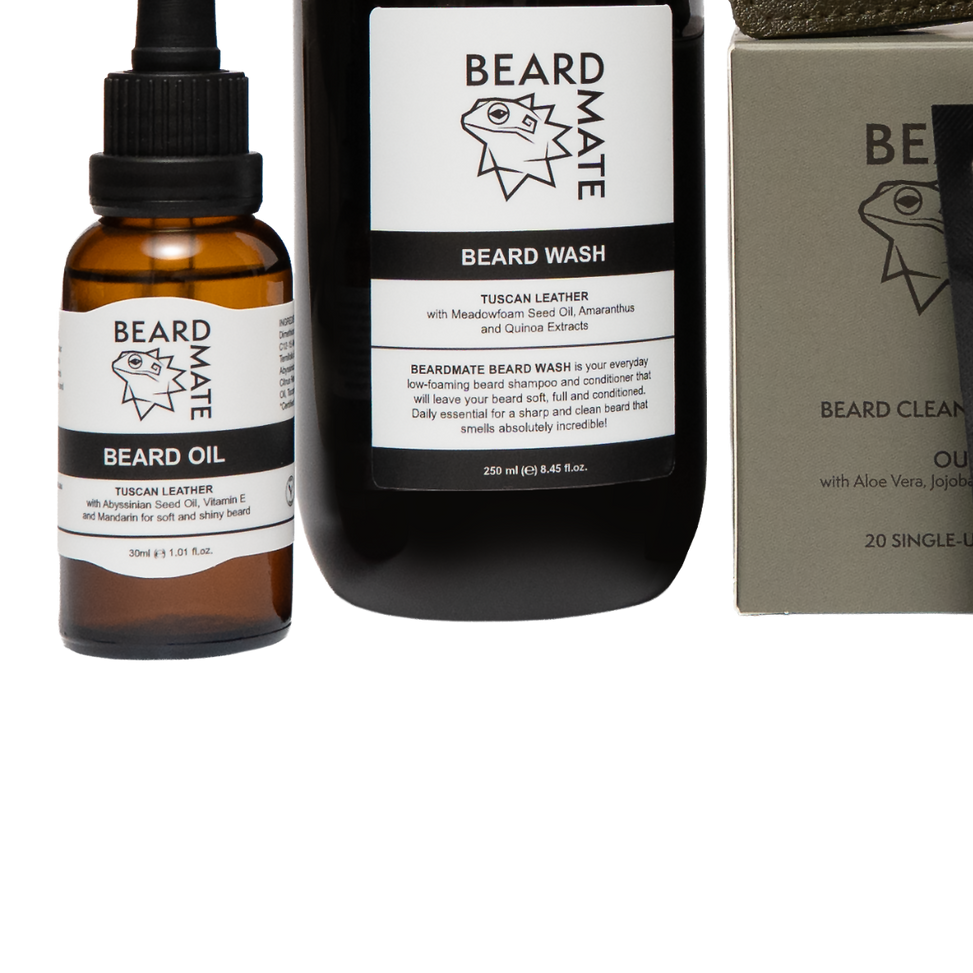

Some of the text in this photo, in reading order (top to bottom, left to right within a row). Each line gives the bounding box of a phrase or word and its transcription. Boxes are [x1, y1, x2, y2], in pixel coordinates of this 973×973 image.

[466, 52, 605, 86] BEARD
[577, 89, 605, 200] MATE
[866, 123, 937, 164] BE
[462, 245, 605, 266] BEARD WASH
[480, 291, 589, 304] TUSCAN LEATHER
[427, 303, 635, 319] with Meadowfoam Seed Oil, Amaranthus
[115, 320, 211, 343] BEARD
[481, 320, 589, 334] and Quinoa Extracts
[411, 357, 648, 375] BEARDMATE BEARD WASH is your everyday
[190, 345, 211, 420] MATE
[408, 370, 651, 392] low-foaming beard shampoo and conditioner that
[414, 386, 645, 406] will leave your beard soft, full and conditioned.
[412, 399, 648, 420] Daily essential for a sharp and clean beard that
[821, 401, 890, 418] BEARD
[461, 418, 607, 434] smells absolutely incredible!
[104, 446, 225, 466] BEARD OIL
[484, 466, 502, 475] 250
[506, 465, 518, 474] ml
[541, 464, 561, 474] 8.45
[820, 474, 849, 487] with
[853, 474, 887, 487] Aloe
[115, 485, 213, 496] TUSCAN LEATHER
[87, 494, 246, 511] with Abyssinian Seed Oil, Vitamin E
[83, 506, 250, 522] and Mandarin for soft and shiny beard
[865, 534, 886, 548] 20
[129, 549, 150, 557] 30ml
[170, 548, 187, 556] 1.01
